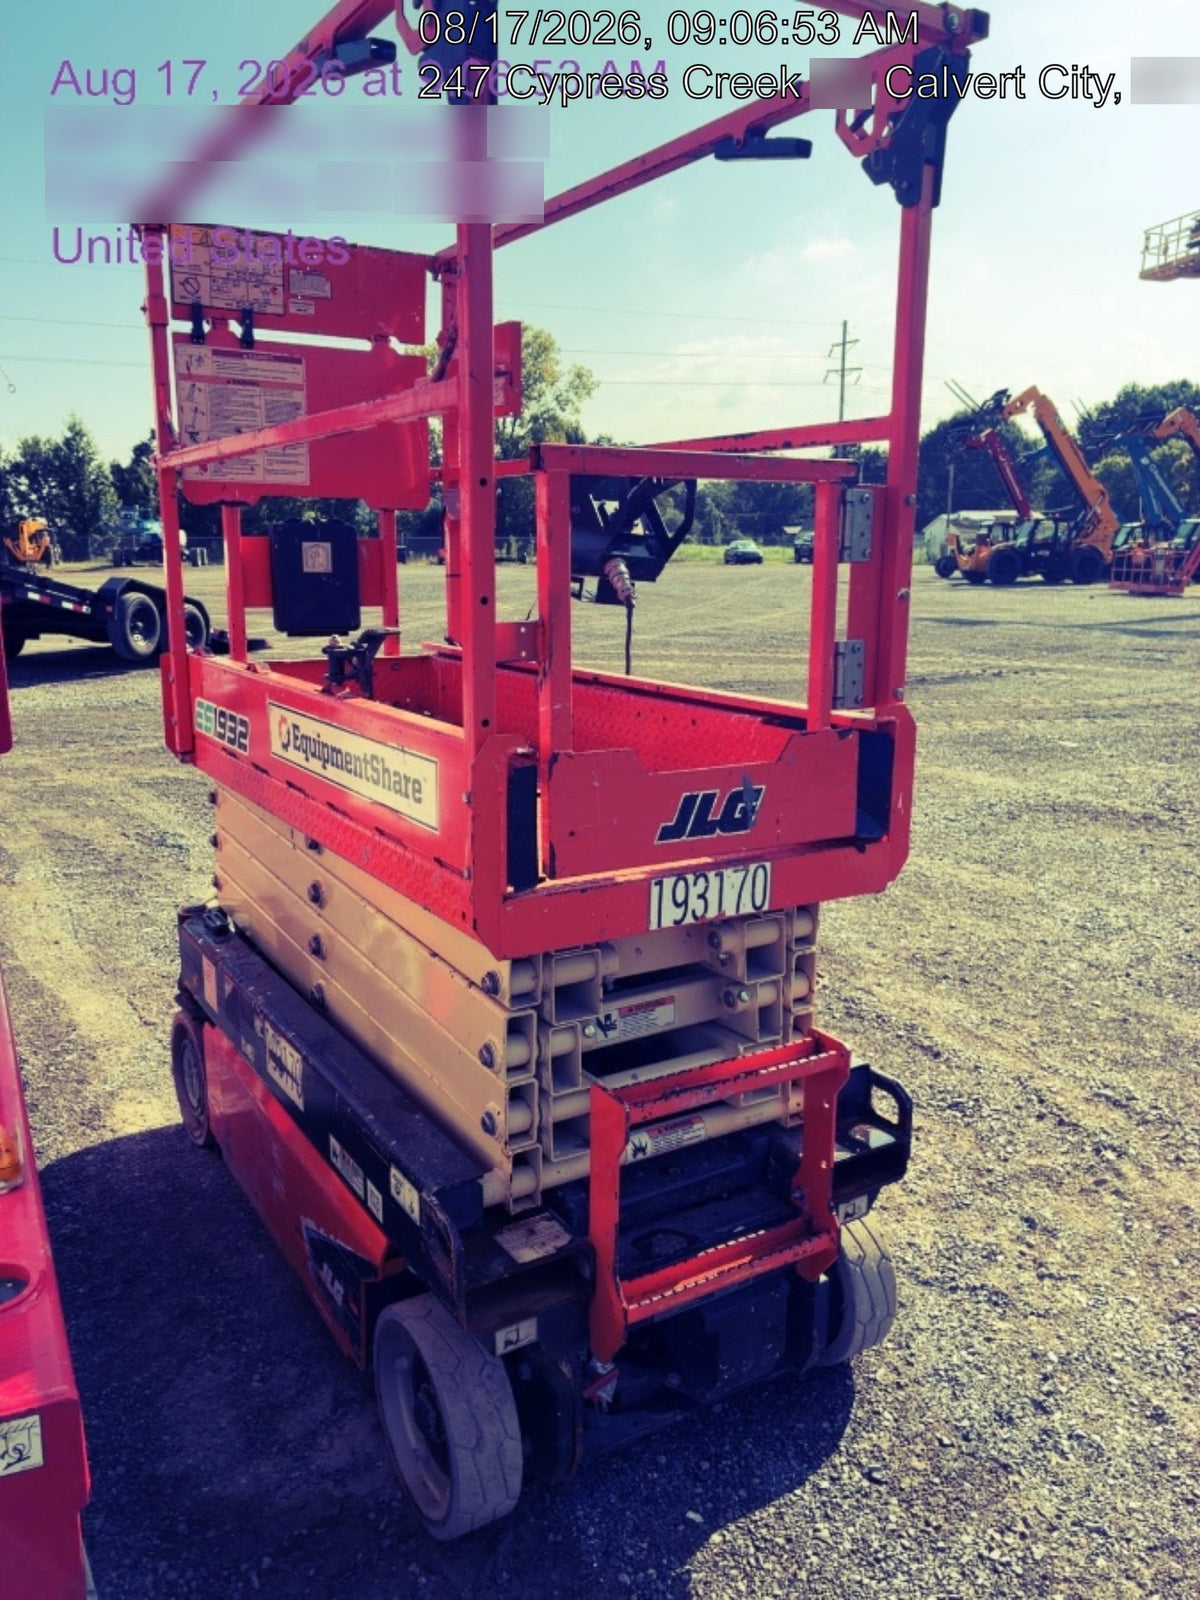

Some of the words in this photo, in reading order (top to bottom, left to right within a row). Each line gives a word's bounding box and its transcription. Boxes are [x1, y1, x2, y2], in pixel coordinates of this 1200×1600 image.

[292, 723, 423, 805] EquipmentShare
[654, 785, 766, 844] JLG
[653, 864, 769, 928] 193170
